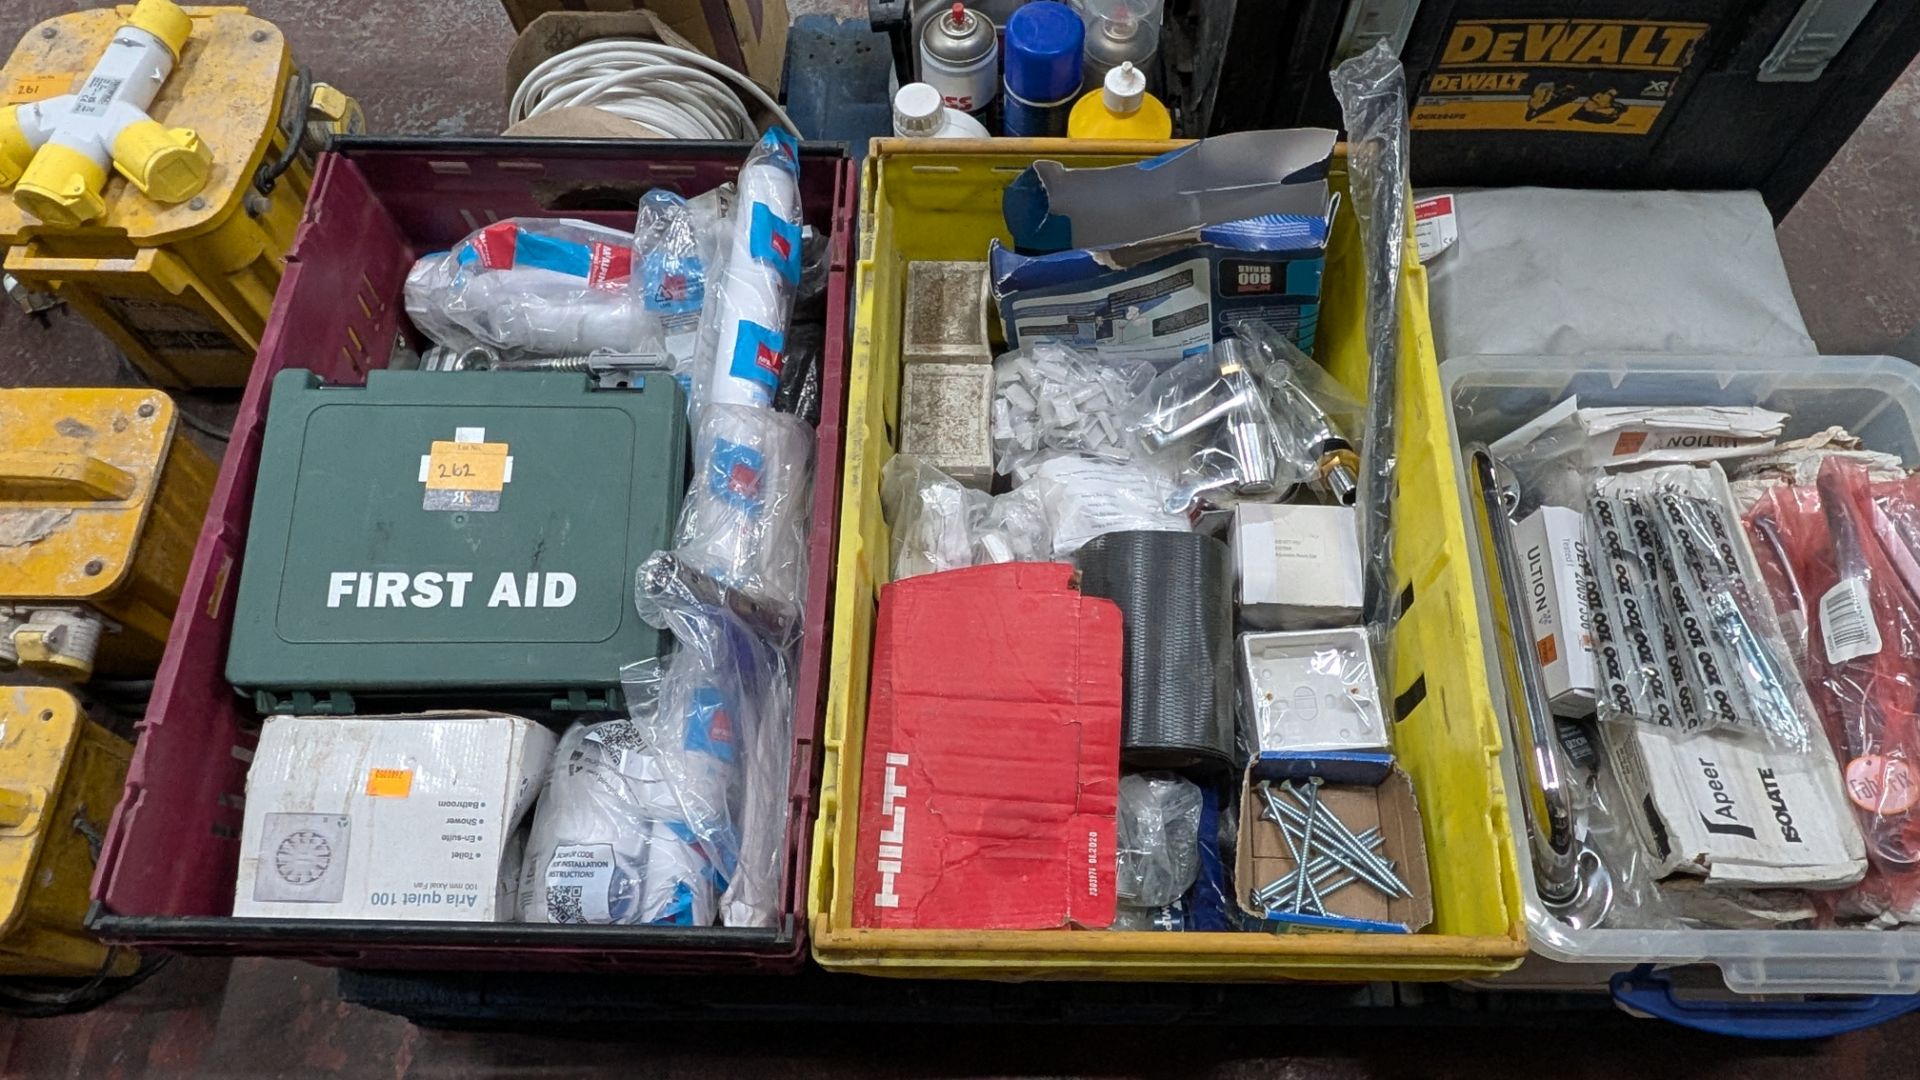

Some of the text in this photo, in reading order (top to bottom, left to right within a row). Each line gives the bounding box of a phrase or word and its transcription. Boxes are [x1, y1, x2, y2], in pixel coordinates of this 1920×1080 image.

[1442, 23, 1703, 66] DEWALT
[1428, 72, 1530, 93] DEWALT
[944, 96, 972, 110] SS
[437, 463, 476, 478] 262
[1596, 500, 1614, 527] ZOO
[1606, 530, 1624, 561] ZOO
[1634, 519, 1654, 548] ZOO
[1678, 529, 1699, 559] ZOO
[1706, 510, 1741, 574] ZOO ZOO
[326, 571, 577, 608] FIRST AID
[1527, 545, 1547, 613] ULTION
[1615, 564, 1633, 595] ZOO
[1593, 612, 1612, 642] ZOO
[1624, 598, 1643, 629] ZOO
[1683, 617, 1707, 648] ZOO
[1603, 646, 1622, 680] ZOO
[1633, 632, 1654, 664] ZOO
[1698, 651, 1722, 686] ZOO
[1612, 683, 1634, 715] ZOO
[1699, 757, 1738, 821] Apeer
[438, 800, 479, 809] Bathroom
[1757, 767, 1803, 843] ISOLATE
[445, 817, 477, 826] Shower
[875, 752, 909, 908] HILTI
[441, 833, 476, 843] En-suite
[451, 851, 474, 860] Toilet
[370, 890, 478, 907] Aria quiet 100
[413, 882, 429, 890] Fan
[430, 882, 449, 891] Axial
[464, 882, 478, 890] 100
